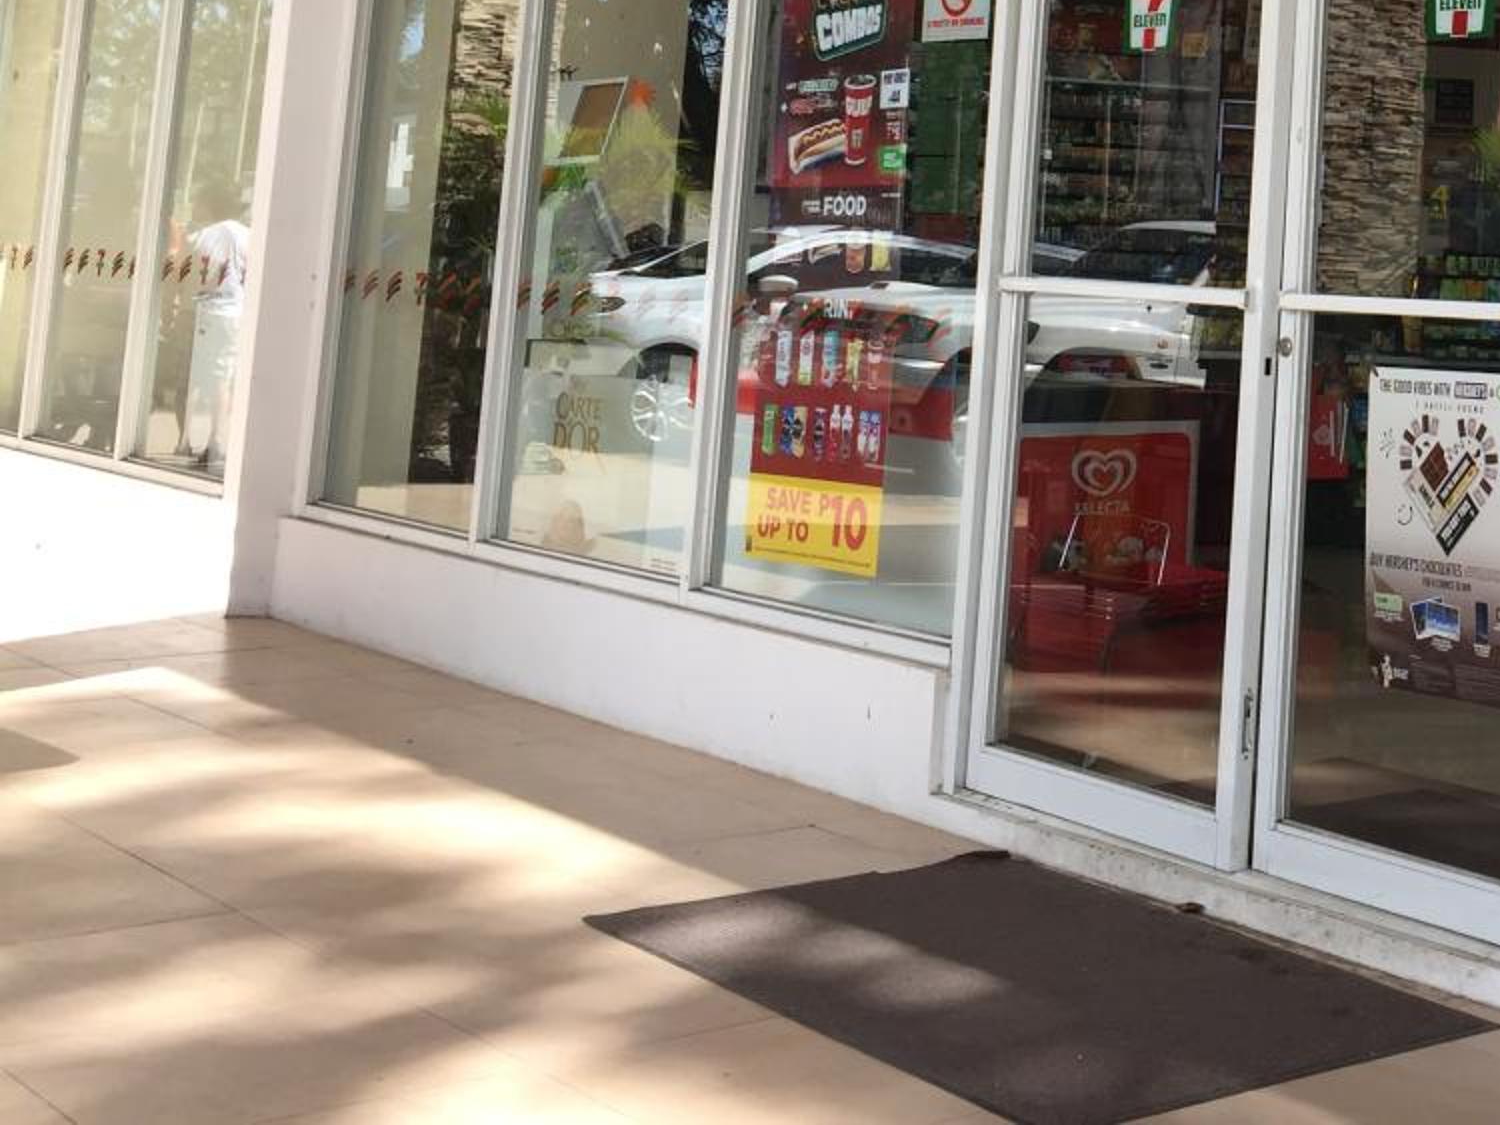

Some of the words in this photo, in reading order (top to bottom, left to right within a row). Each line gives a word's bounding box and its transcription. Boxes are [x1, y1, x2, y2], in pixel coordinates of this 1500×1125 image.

[823, 195, 867, 216] FOOD
[767, 486, 812, 515] SAVE
[757, 515, 781, 539] UP
[786, 518, 809, 543] TO
